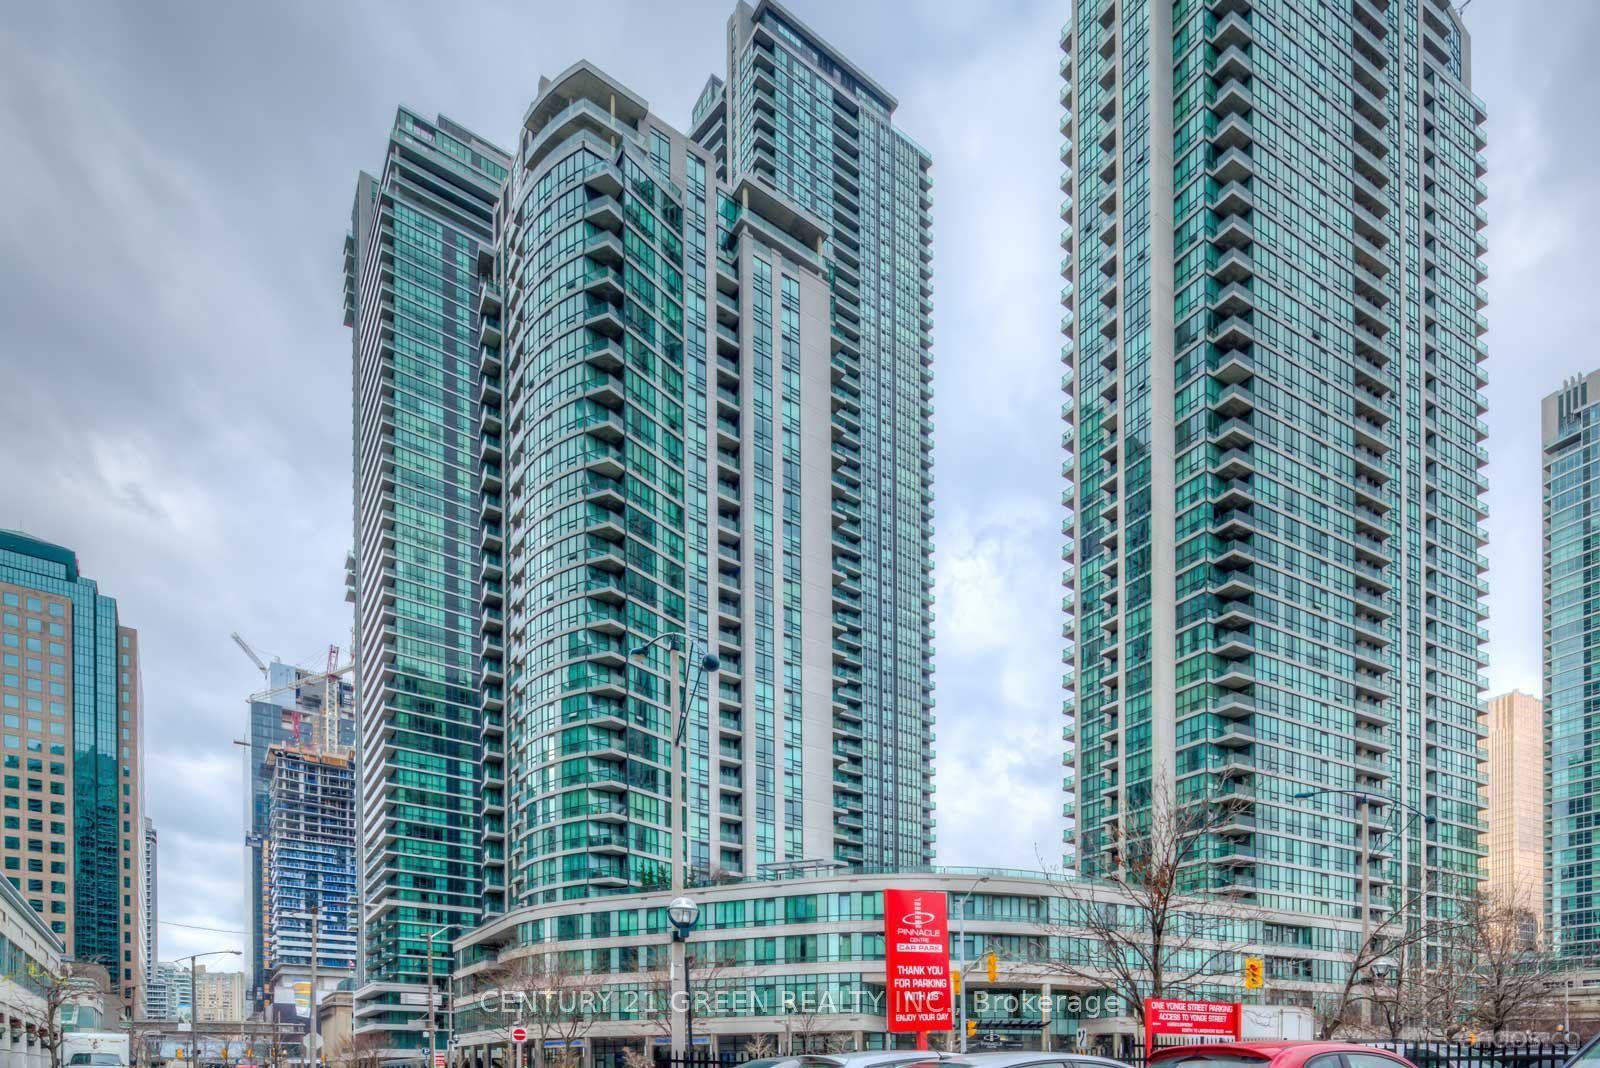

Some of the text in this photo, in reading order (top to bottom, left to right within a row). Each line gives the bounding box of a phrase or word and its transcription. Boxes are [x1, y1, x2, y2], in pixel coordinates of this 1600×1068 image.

[897, 928, 940, 937] PINNACLE
[897, 965, 944, 975] THANK YOU
[894, 978, 947, 988] FOR PARKING
[904, 991, 939, 1001] WITH US
[1151, 1001, 1165, 1010] ONE
[1187, 1003, 1208, 1012] STREET
[1208, 1004, 1233, 1013] PARKING
[895, 1014, 917, 1022] ENJOY
